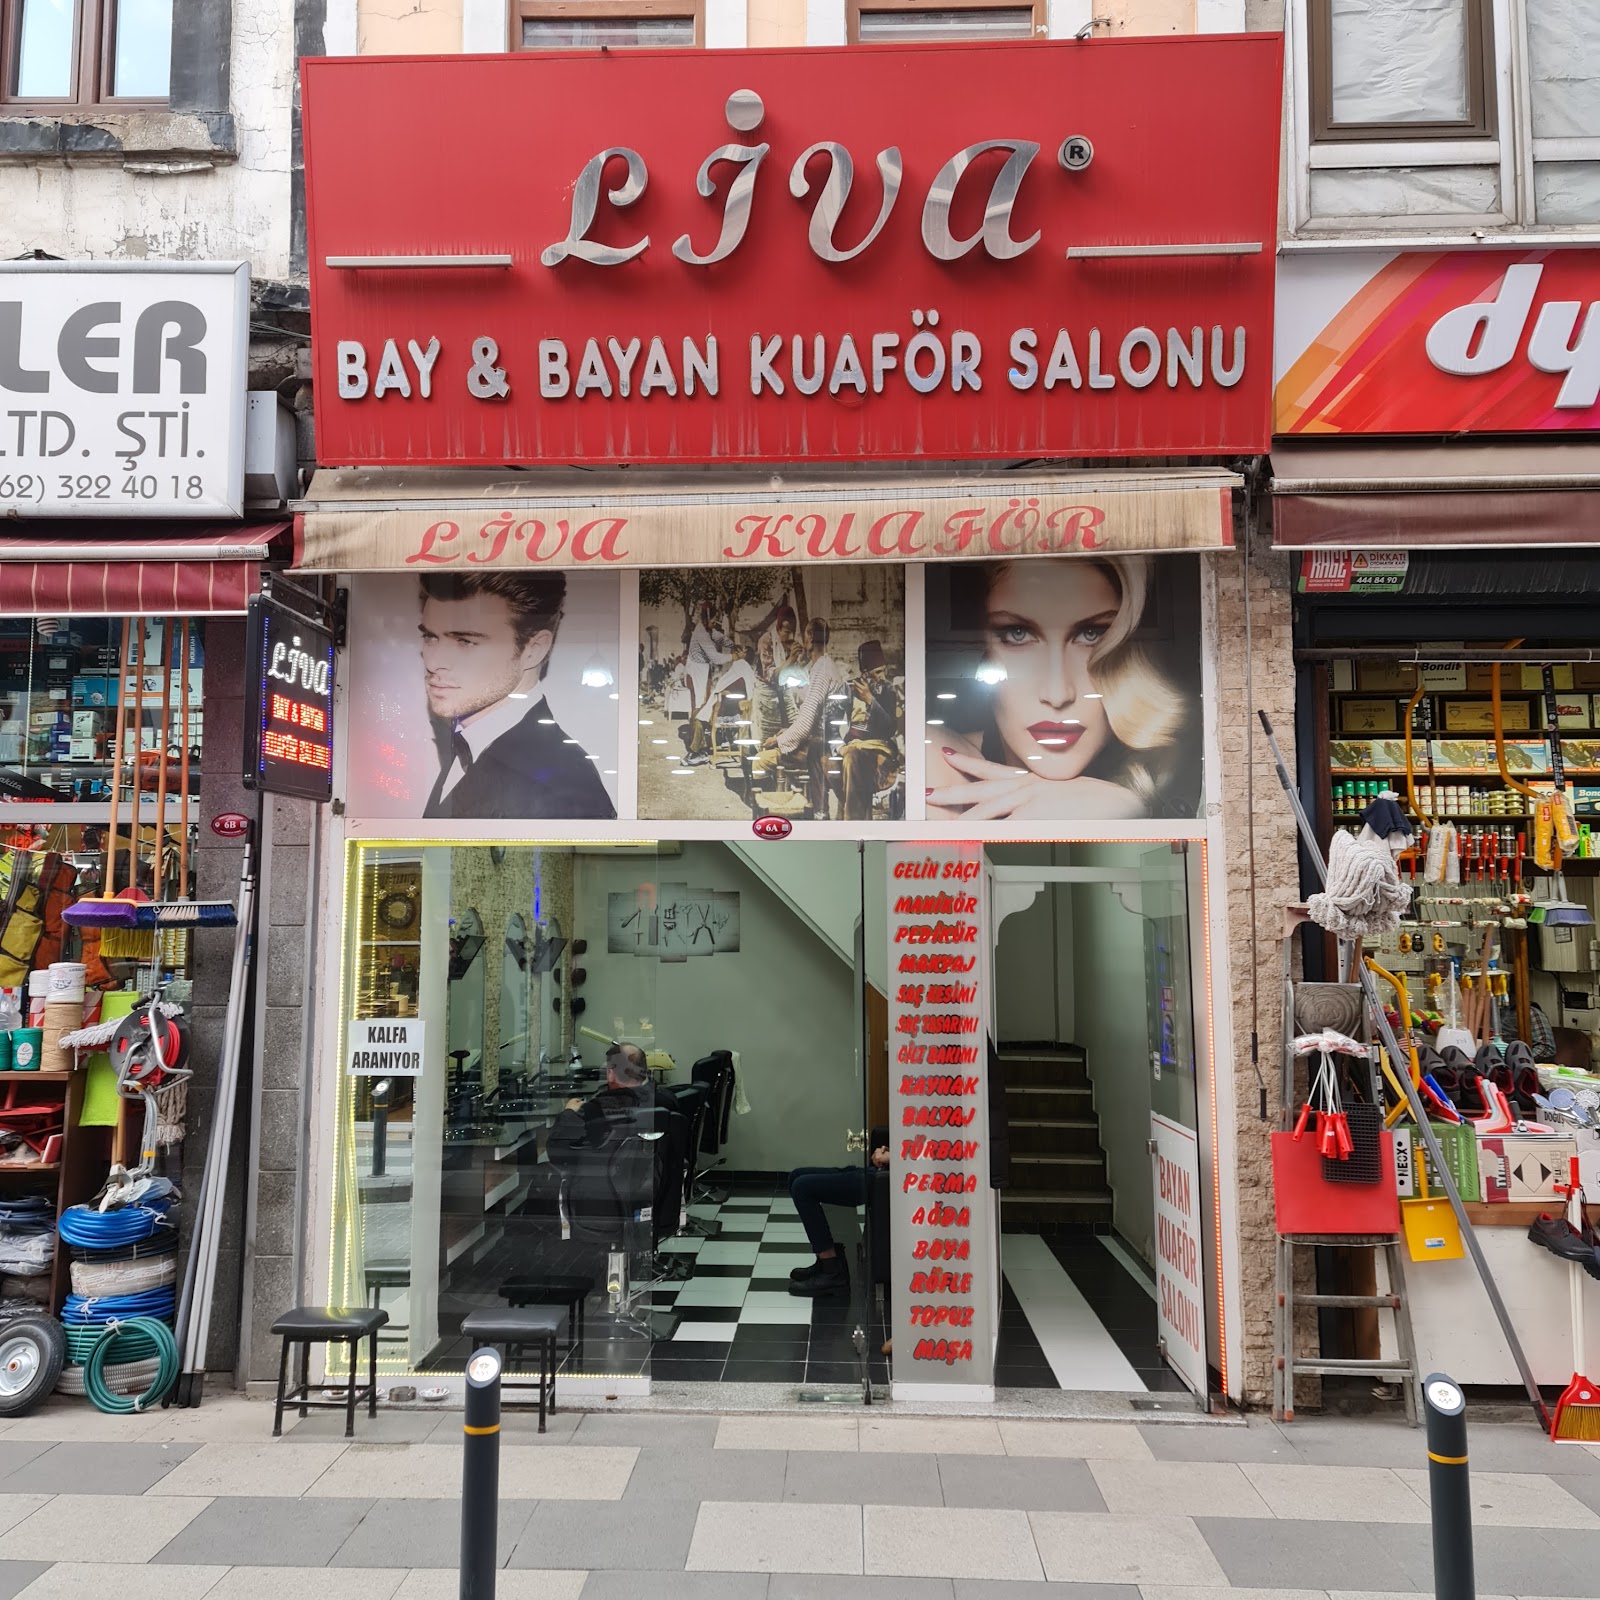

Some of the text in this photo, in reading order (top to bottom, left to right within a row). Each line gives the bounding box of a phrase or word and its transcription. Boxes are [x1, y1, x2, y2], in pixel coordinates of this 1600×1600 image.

[0, 300, 207, 394] LER
[1425, 263, 1600, 409] dy
[337, 309, 1247, 399] BAY & BAYAN KUAFÖR SALONU
[0, 401, 205, 472] TD. ŞTİ.
[57, 475, 111, 499] 322
[121, 475, 157, 499] 40
[171, 475, 204, 499] 18
[722, 498, 1110, 558] KUAFÖR
[1369, 552, 1406, 561] DİKKAT!
[1356, 576, 1398, 584] 444 84 90
[1420, 662, 1461, 671] Bondit
[223, 820, 237, 829] 6B
[765, 823, 779, 832] 6A
[894, 856, 981, 883] GELİN SAÇI
[893, 920, 978, 944] PEDİKÜR
[898, 954, 976, 974] MAKYAJ
[896, 980, 979, 1009] SAÇ KESİMİ
[367, 1026, 407, 1044] KALFA
[895, 1013, 979, 1039] SAÇ TASARIMI
[351, 1051, 420, 1069] ARANIYOR
[897, 1039, 979, 1065] CİLT BAKIMI
[898, 1075, 979, 1097] KAYNAK
[901, 1105, 976, 1128] BALYAJ
[900, 1134, 979, 1161] TÜRBAN
[902, 1172, 978, 1194] PERMA
[1158, 1154, 1192, 1219] BAYAN
[911, 1200, 970, 1228] AĞDA
[912, 1238, 970, 1261] BOYA
[1158, 1212, 1199, 1288] KUAFÖR
[909, 1266, 973, 1294] RÖFLE
[909, 1305, 975, 1328] TOPUZ
[1160, 1272, 1200, 1354] SALONU
[912, 1339, 974, 1366] MAŞA
